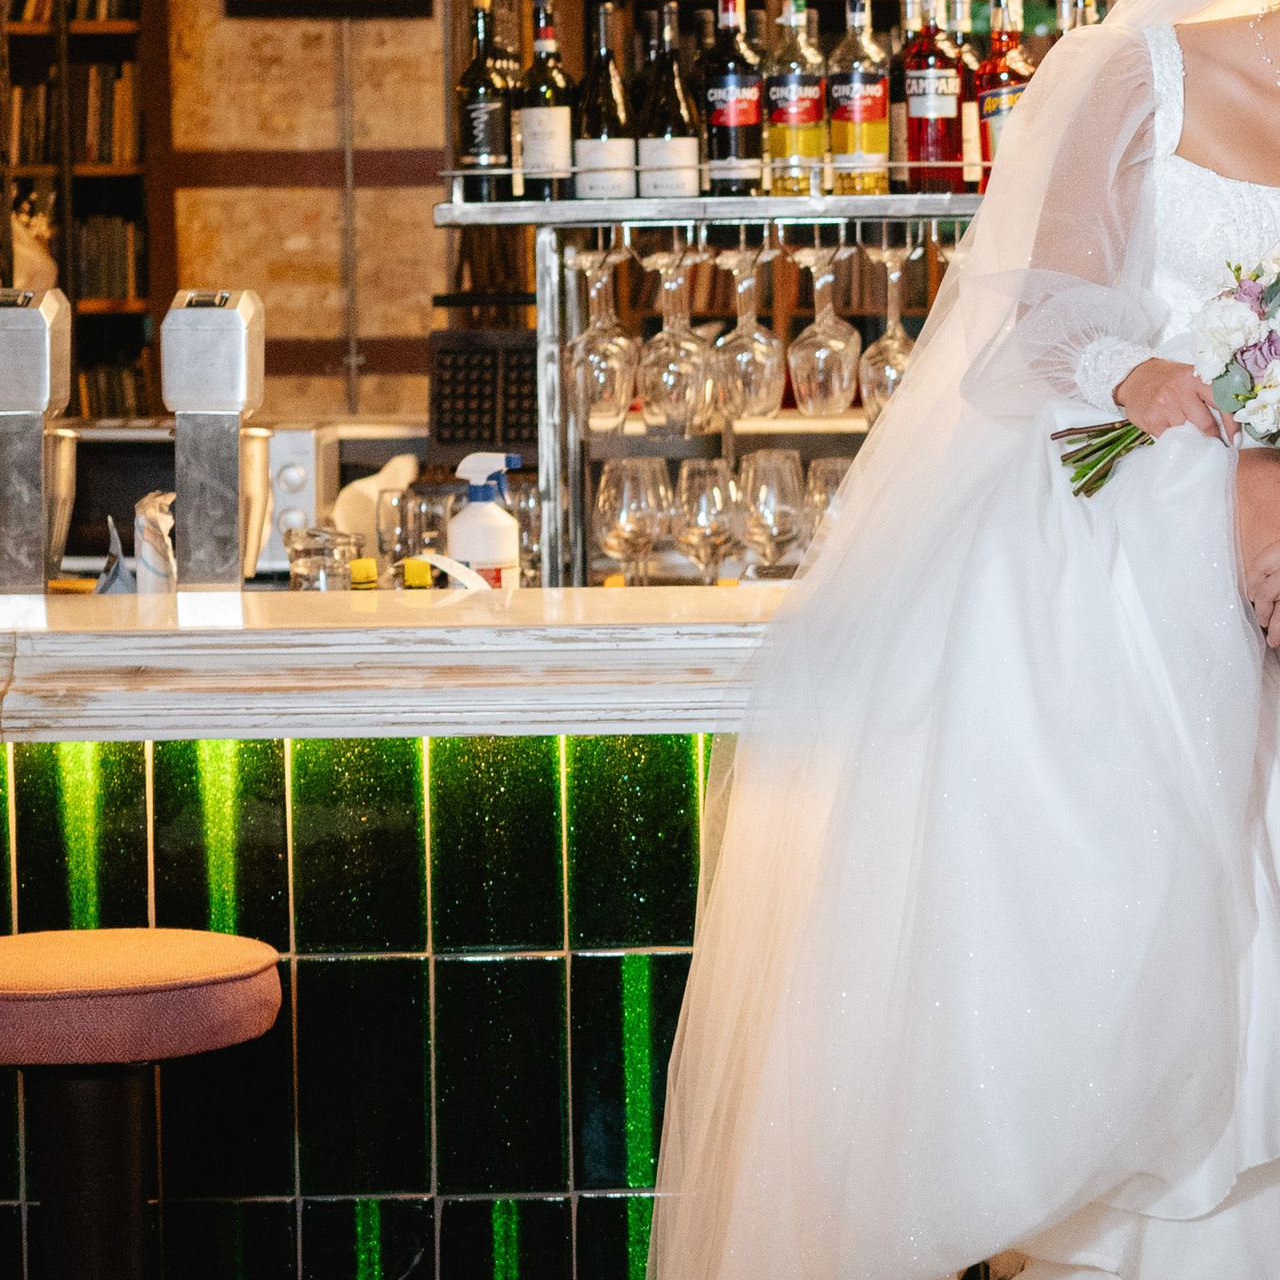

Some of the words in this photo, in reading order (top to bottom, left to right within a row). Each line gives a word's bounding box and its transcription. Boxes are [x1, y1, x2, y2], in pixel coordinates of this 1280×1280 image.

[707, 86, 760, 102] CINZANO
[769, 84, 821, 101] CINZANO
[832, 83, 884, 99] CINZANO
[906, 77, 962, 95] CAMPARI
